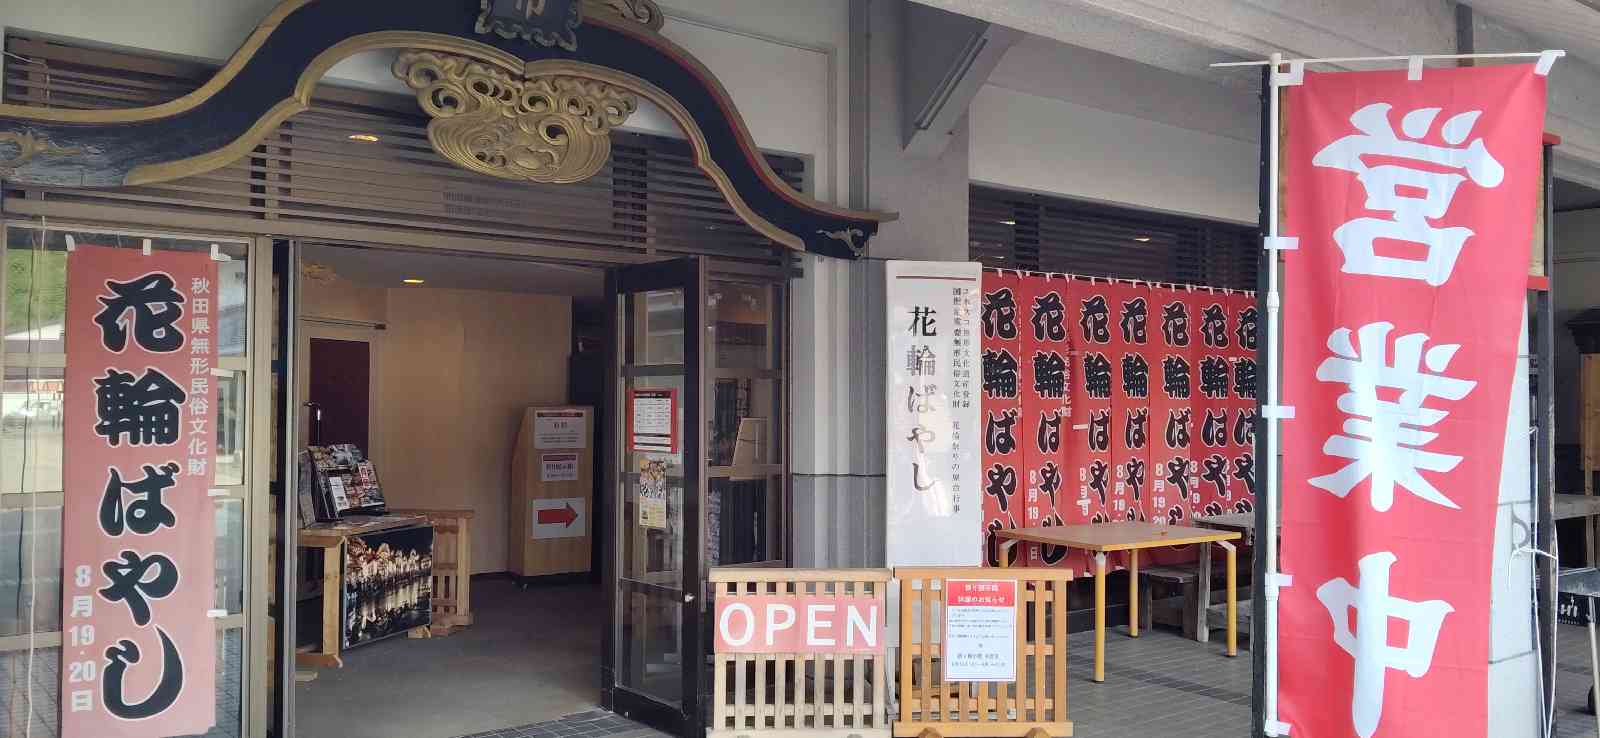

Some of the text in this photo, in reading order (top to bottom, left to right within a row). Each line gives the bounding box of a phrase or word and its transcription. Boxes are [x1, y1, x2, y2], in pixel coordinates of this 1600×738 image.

[187, 277, 211, 477] 秋田県無形民俗文化財
[906, 305, 938, 491] 花輪ばやし
[1310, 102, 1504, 737] 営業中
[92, 271, 187, 720] 花輪ばやし
[719, 602, 878, 647] OPEN
